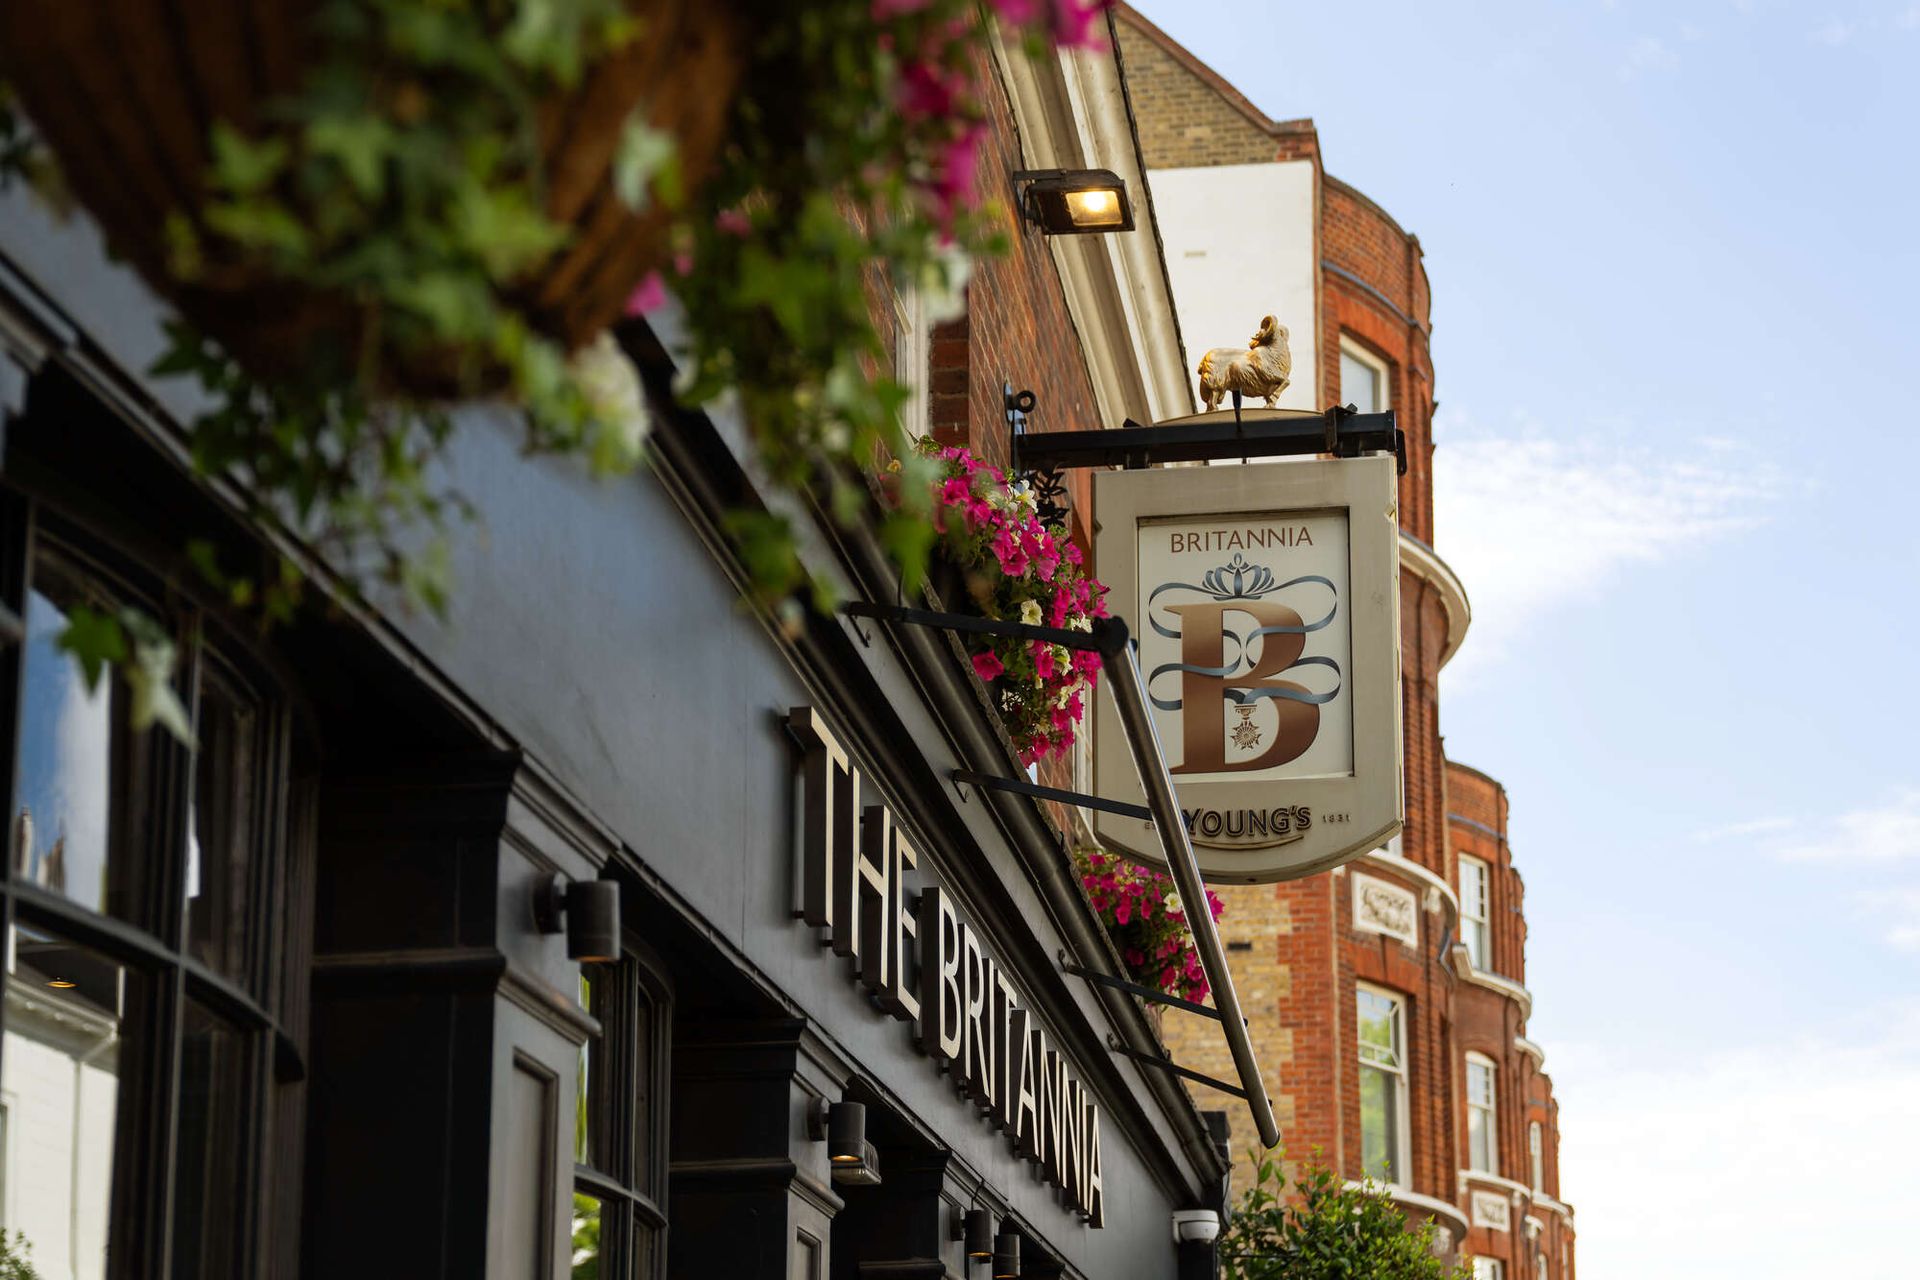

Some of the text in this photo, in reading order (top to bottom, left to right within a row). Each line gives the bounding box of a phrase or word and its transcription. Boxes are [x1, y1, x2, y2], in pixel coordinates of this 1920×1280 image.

[1170, 526, 1314, 553] BRITANNIA
[1163, 602, 1320, 774] B
[1182, 806, 1312, 837] YOUNG'S
[808, 706, 1105, 1229] THE BRITANNIA
